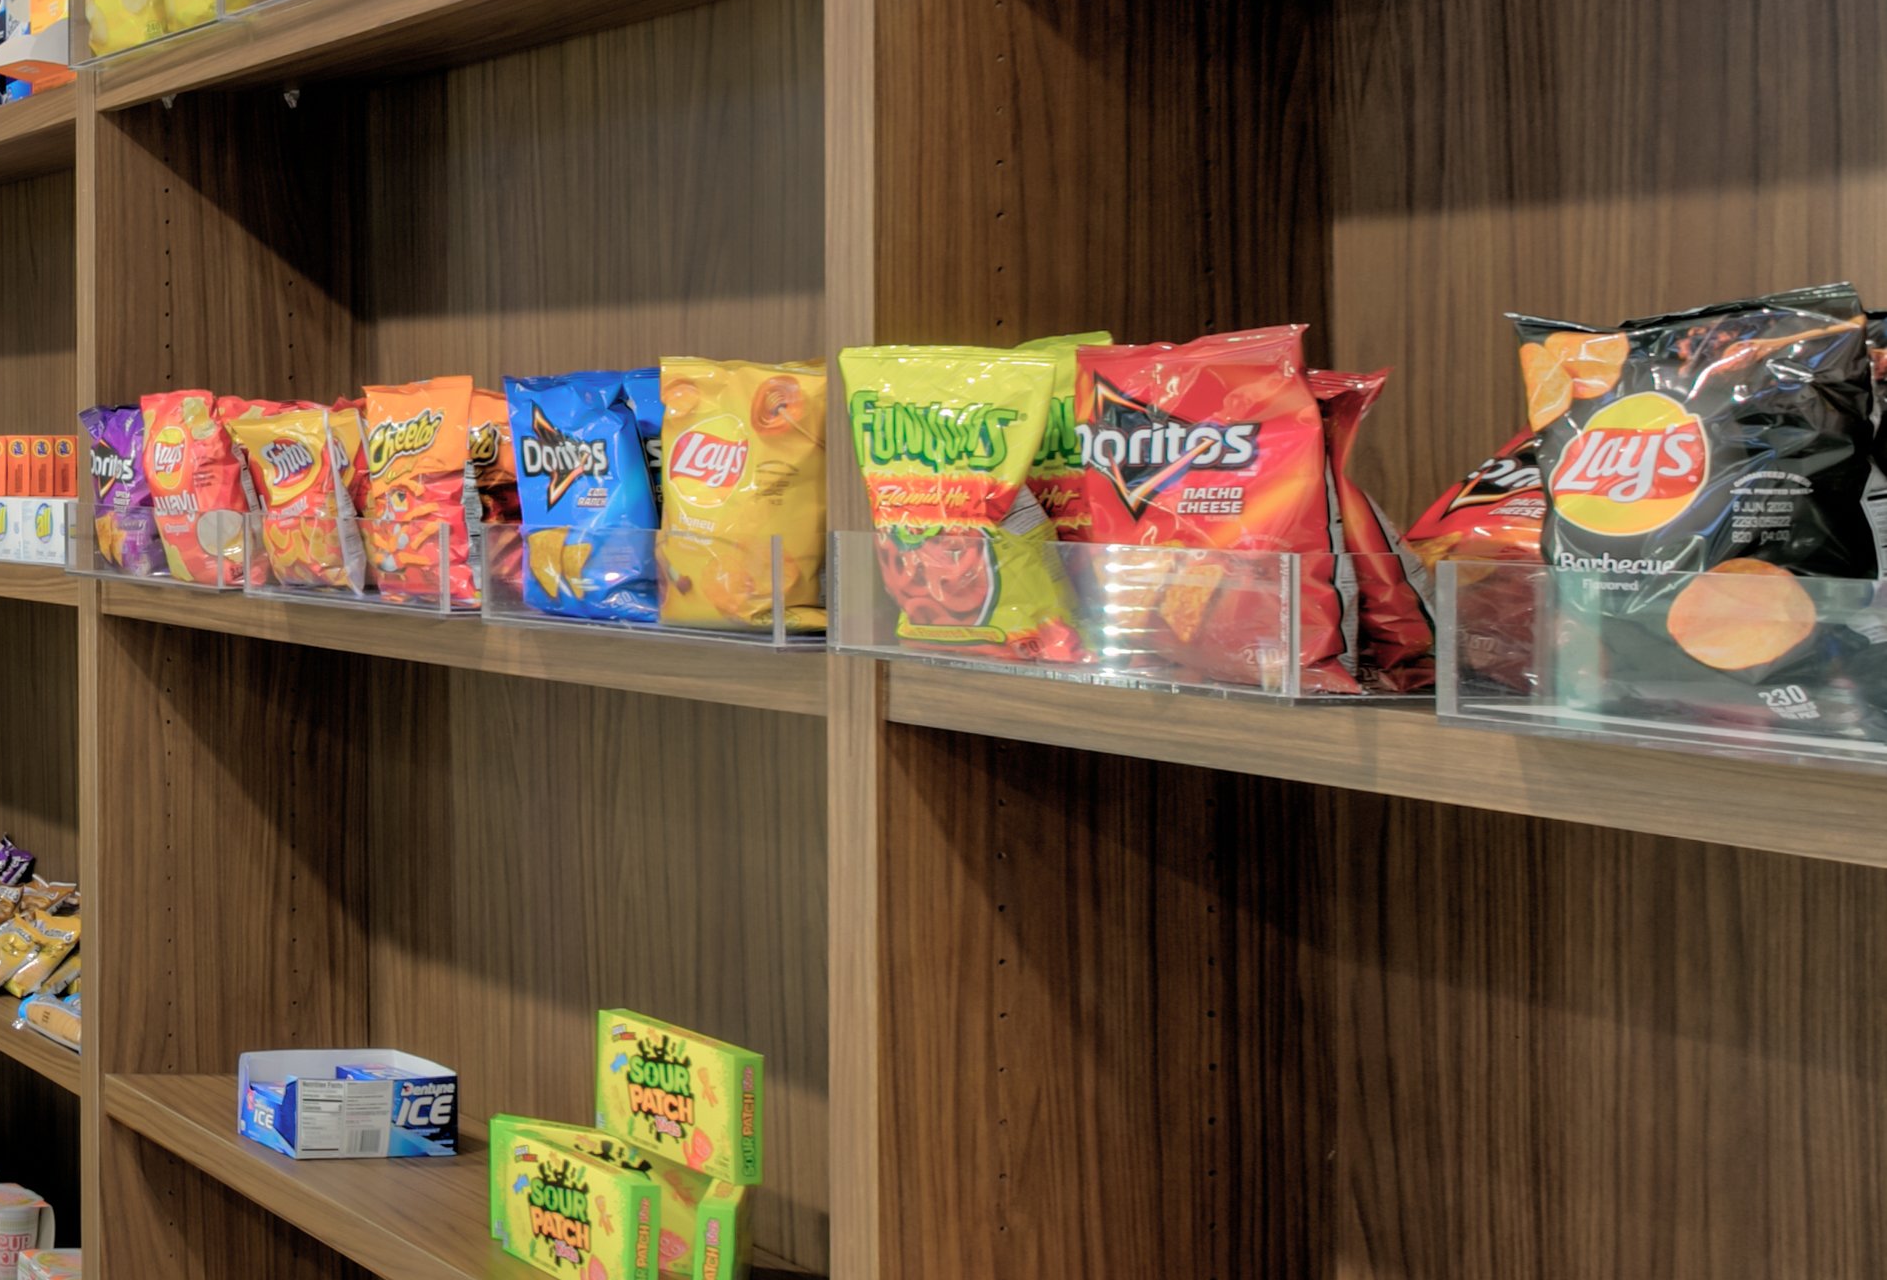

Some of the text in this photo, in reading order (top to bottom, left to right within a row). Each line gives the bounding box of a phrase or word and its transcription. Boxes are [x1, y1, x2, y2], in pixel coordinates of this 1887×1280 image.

[523, 436, 607, 473] Doritos
[673, 433, 747, 488] Lay's
[1555, 425, 1696, 502] Lay's
[1177, 500, 1244, 515] CHEESE
[1183, 487, 1244, 501] NACHO
[1742, 501, 1794, 513] JUN 2023
[36, 506, 51, 536] all
[1557, 552, 1676, 575] Barbecue
[1582, 578, 1639, 592] Flavored
[1759, 685, 1807, 708] 230
[401, 1081, 455, 1097] Dentyne
[628, 1054, 691, 1095] SOUR
[253, 1109, 274, 1129] ICE
[396, 1095, 453, 1126] ICE
[629, 1083, 694, 1124] PATCH
[742, 1094, 756, 1177] SOUR PATCH
[529, 1177, 589, 1222] SOUR
[529, 1205, 591, 1252] PATCH
[637, 1224, 650, 1268] PATCH
